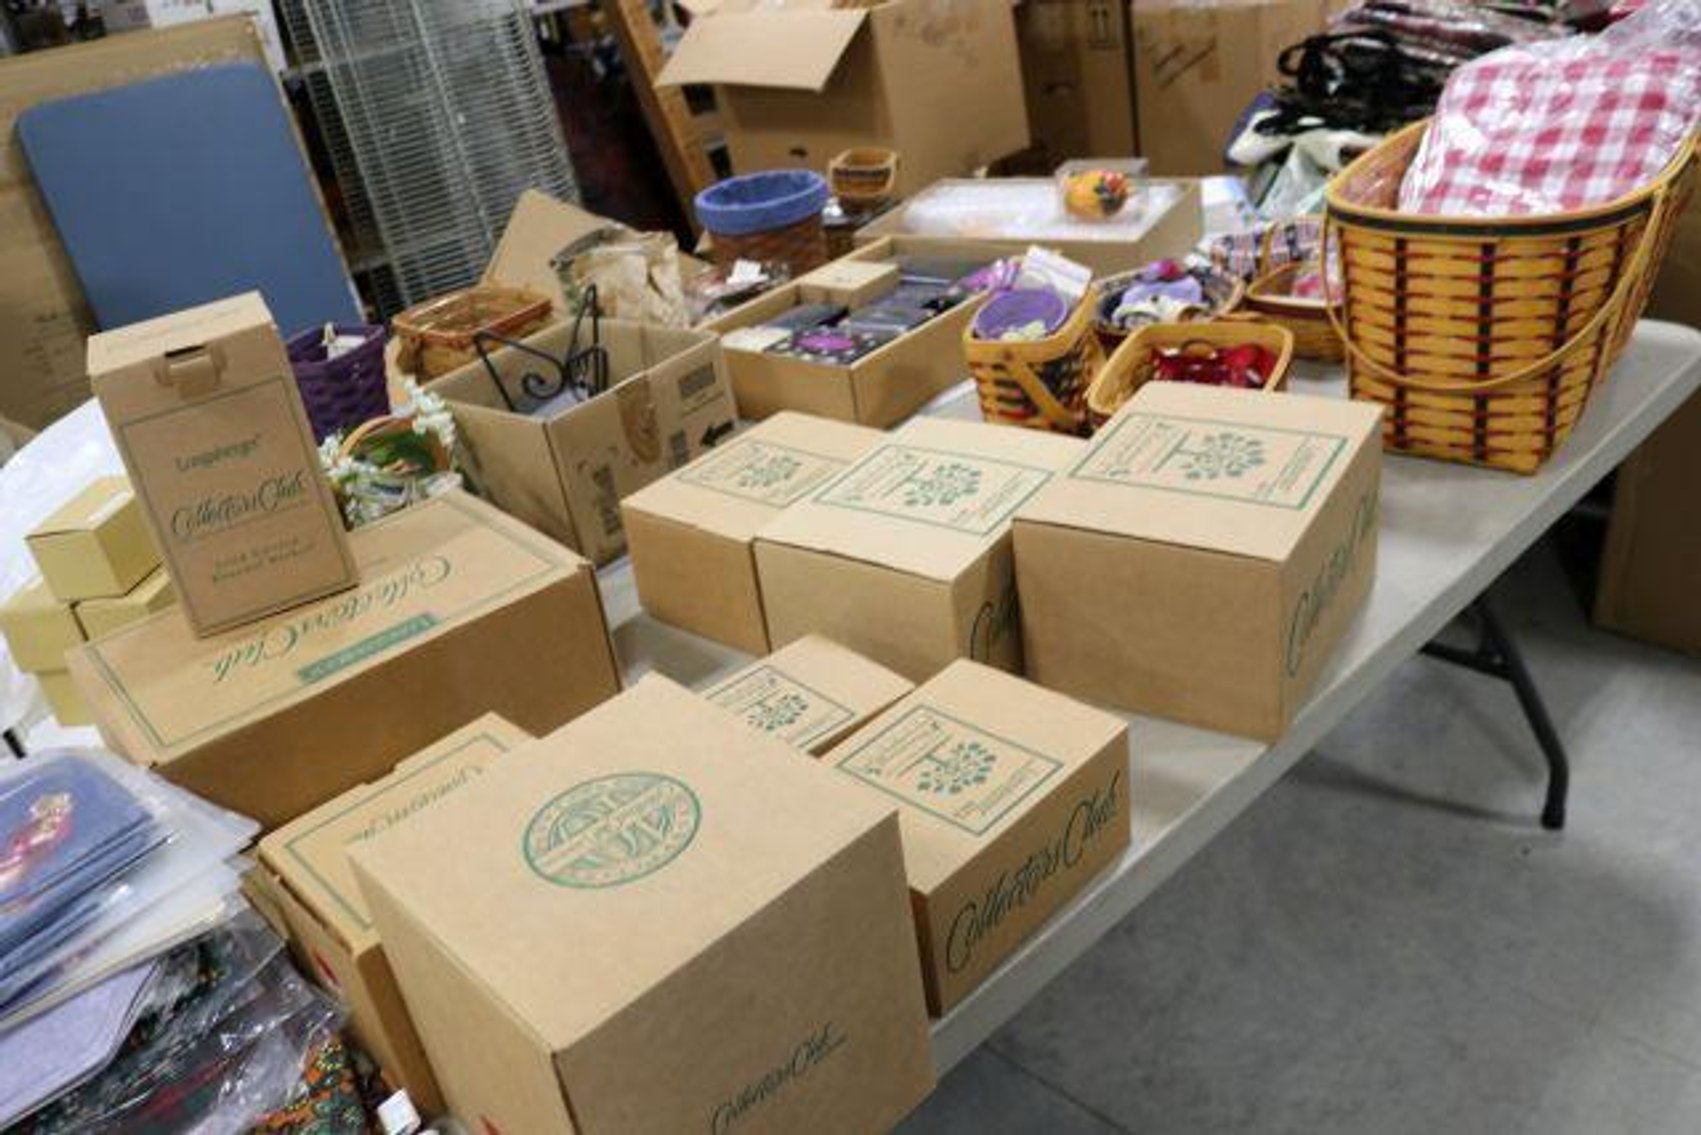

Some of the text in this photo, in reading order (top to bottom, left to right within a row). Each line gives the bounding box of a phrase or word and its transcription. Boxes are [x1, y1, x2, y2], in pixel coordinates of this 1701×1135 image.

[258, 470, 304, 511] Club
[946, 838, 1062, 973] Collectors
[1063, 769, 1121, 868] Club
